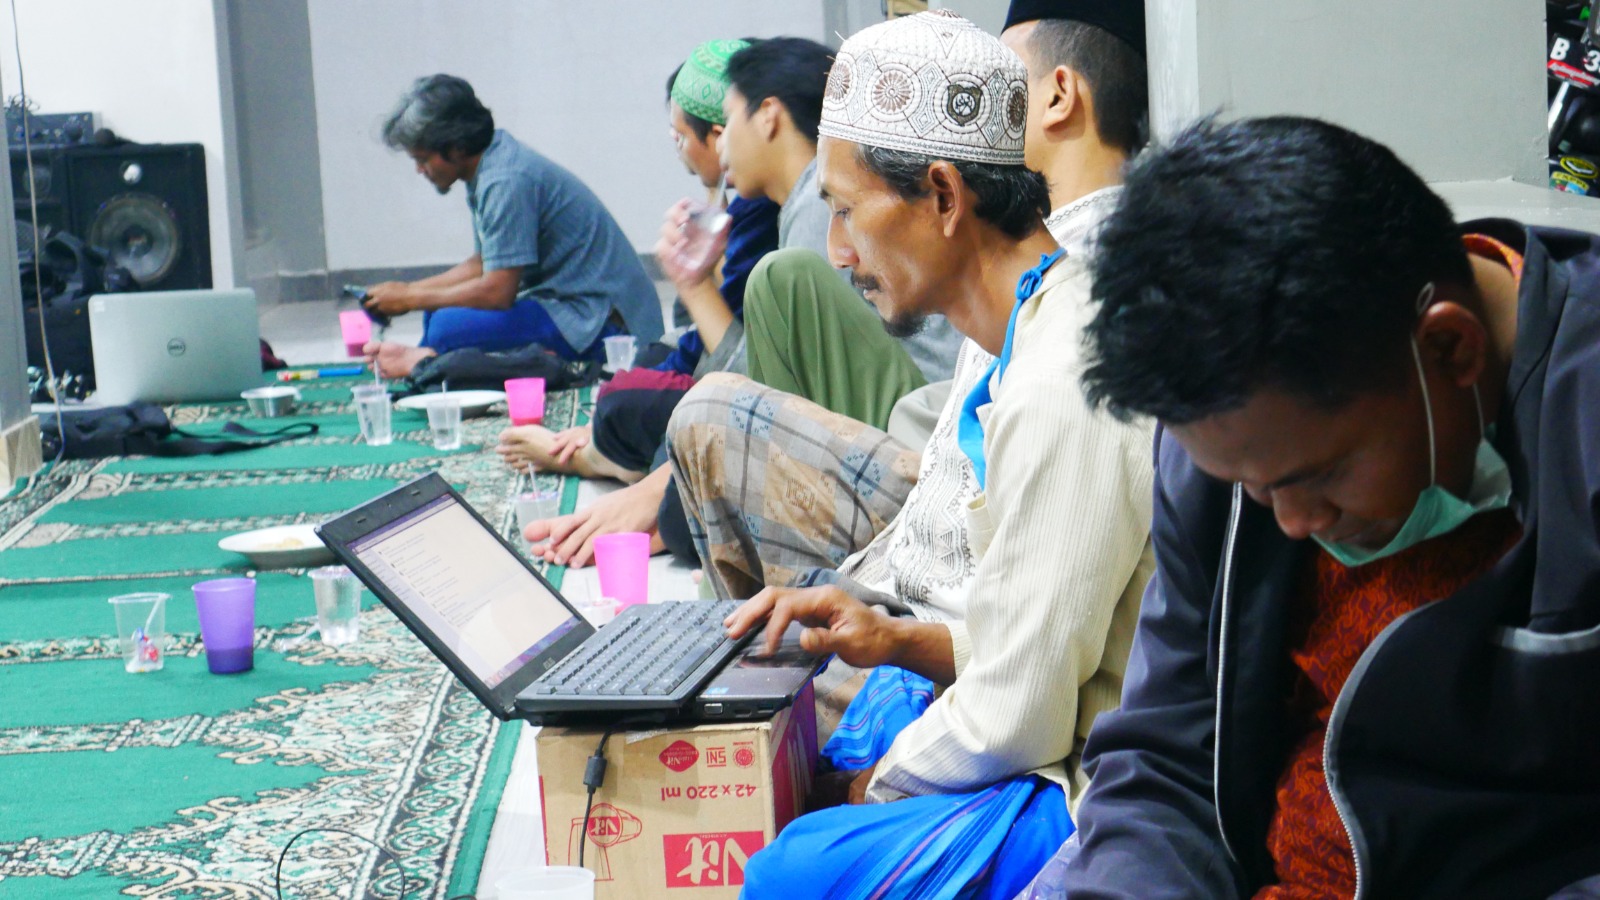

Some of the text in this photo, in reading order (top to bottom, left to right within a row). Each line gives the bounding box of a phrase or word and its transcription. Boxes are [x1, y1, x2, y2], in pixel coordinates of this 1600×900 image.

[1550, 37, 1600, 73] B 3
[706, 750, 727, 765] SNI
[661, 783, 757, 801] 42 x 220 ml
[590, 817, 618, 836] Vit
[676, 836, 749, 887] Vit
